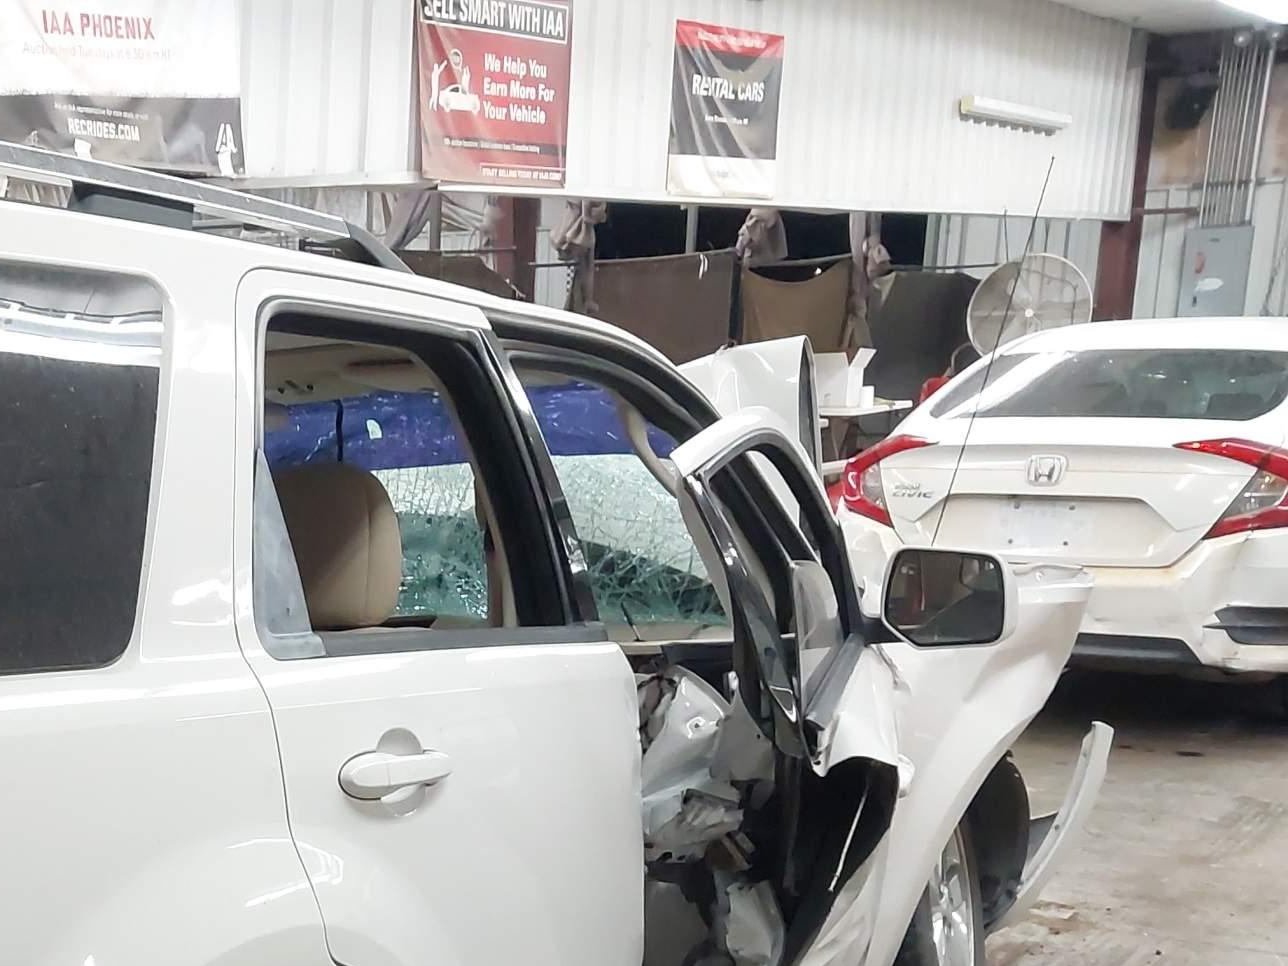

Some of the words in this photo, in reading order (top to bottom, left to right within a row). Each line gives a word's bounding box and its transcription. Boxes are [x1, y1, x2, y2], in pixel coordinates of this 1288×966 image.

[42, 9, 74, 36] IAA
[80, 12, 155, 41] PHOENIX
[460, 0, 507, 28] SMART
[508, 3, 540, 34] WITH
[543, 9, 564, 37] IAA
[484, 52, 500, 73] We
[503, 55, 527, 79] Help
[529, 59, 547, 79] You
[483, 77, 508, 97] Earn
[509, 80, 536, 100] More
[538, 83, 555, 102] For
[692, 74, 735, 100] RENTAL
[738, 82, 764, 103] CARS
[483, 100, 508, 121] Your
[509, 103, 546, 125] Vehicle
[67, 117, 140, 142] RECRIDES.COM
[892, 490, 934, 499] CIVIC
